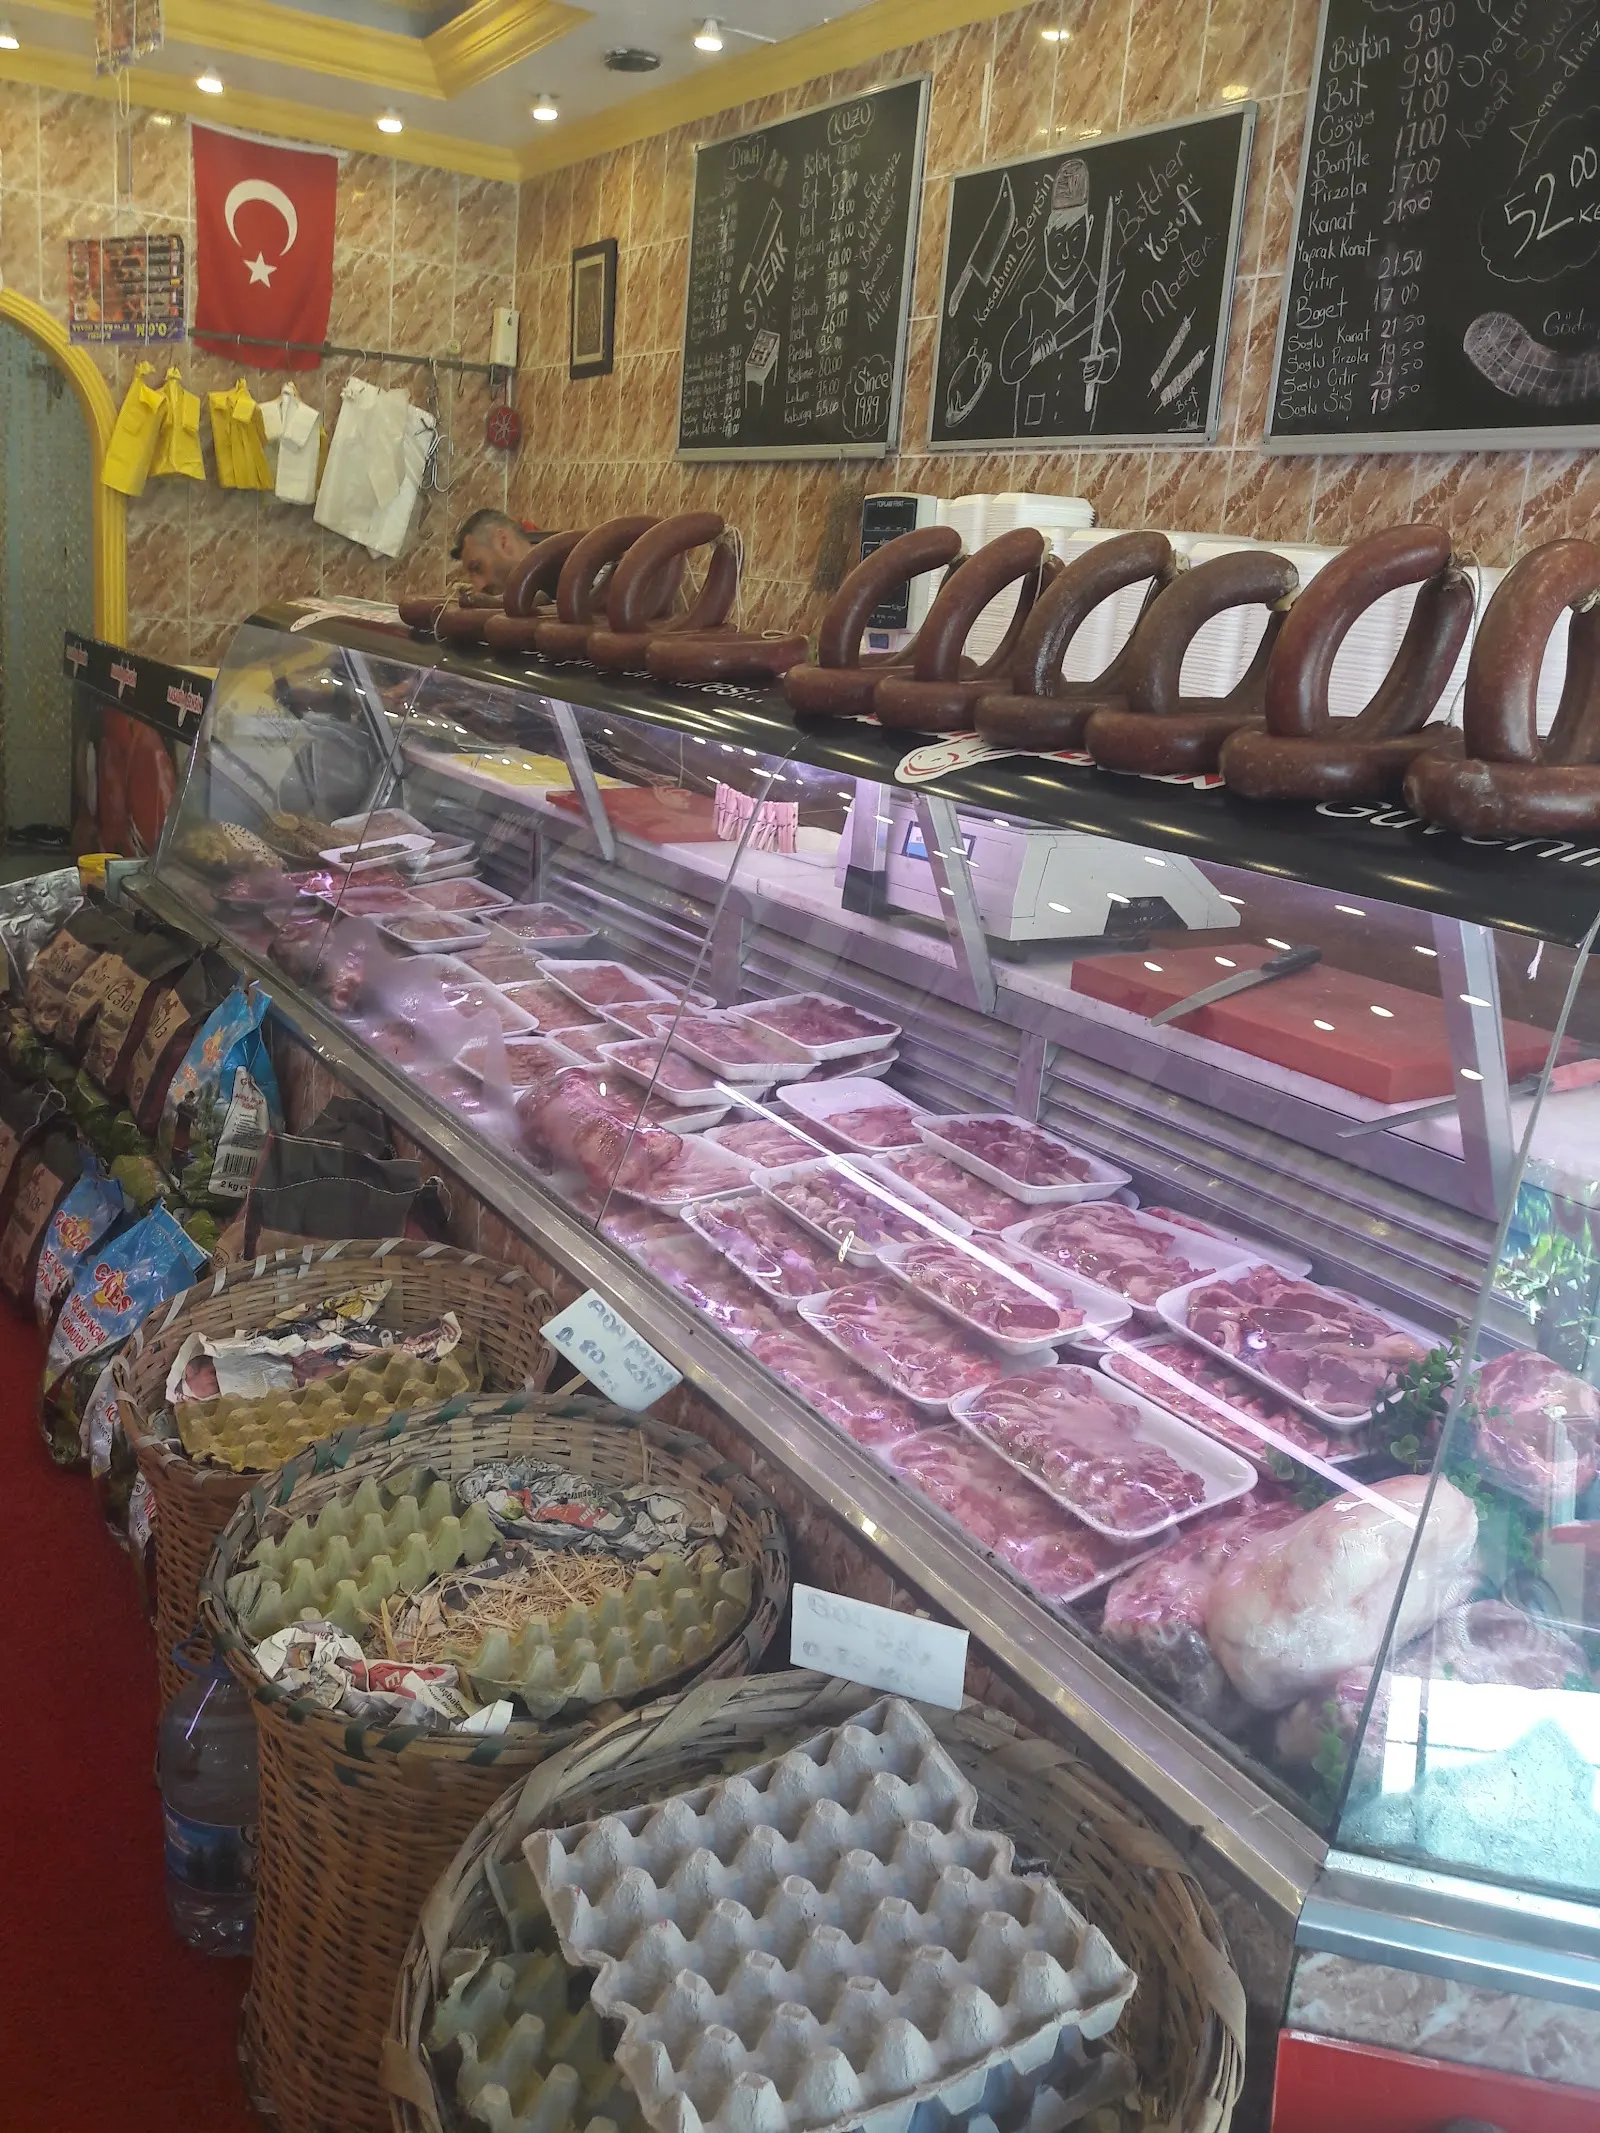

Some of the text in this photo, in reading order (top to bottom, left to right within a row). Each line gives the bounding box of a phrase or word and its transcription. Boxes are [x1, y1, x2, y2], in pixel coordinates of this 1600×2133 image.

[1329, 25, 1390, 72] Bütün
[1323, 68, 1368, 112] But
[1313, 137, 1370, 178] Bonfile
[1117, 140, 1187, 262] Butcher
[1310, 173, 1368, 205] Pirzola
[1308, 202, 1356, 237] Kanat
[1297, 231, 1380, 268] Yaprak Kanat
[743, 231, 789, 331] STEAK
[1296, 287, 1348, 329] Baget
[1337, 320, 1371, 344] Kanat
[1332, 346, 1369, 364] Pirzola
[854, 366, 889, 396] Since
[854, 395, 880, 428] 1989
